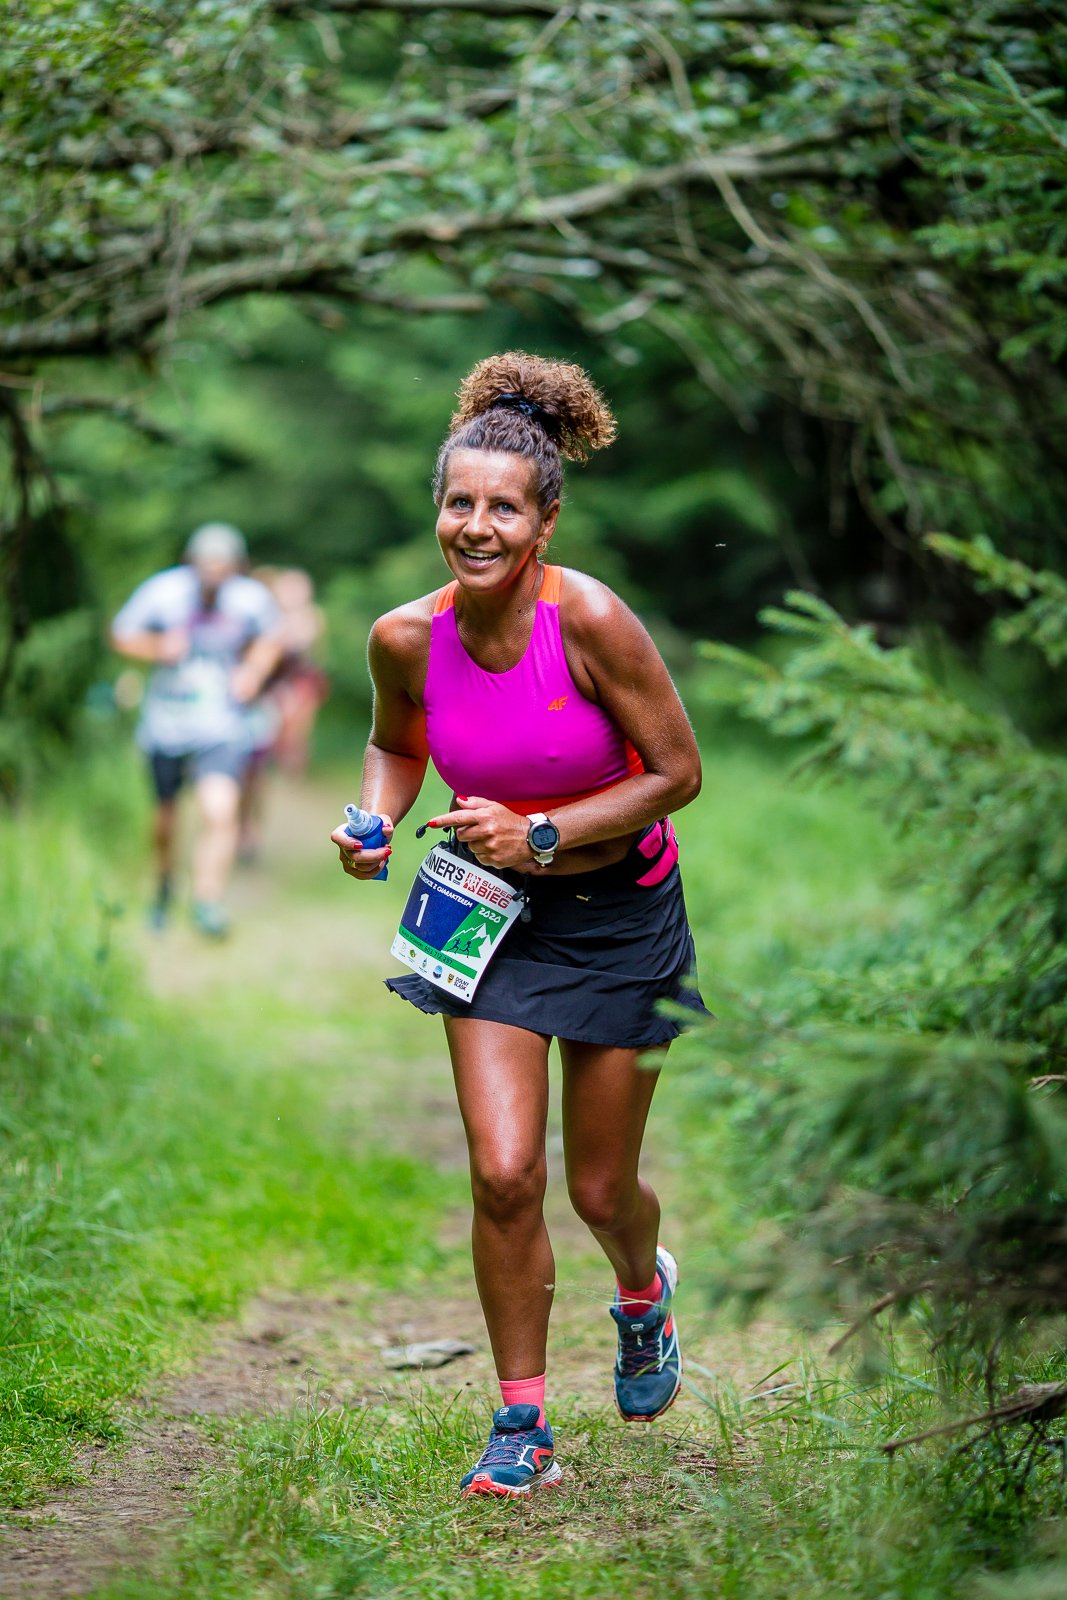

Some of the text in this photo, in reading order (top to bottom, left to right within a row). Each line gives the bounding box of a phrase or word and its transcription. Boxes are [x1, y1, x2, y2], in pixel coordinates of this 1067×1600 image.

[436, 886, 474, 908] CHARAKTEREM
[476, 886, 510, 909] BIEG
[481, 880, 513, 902] SUPER
[415, 893, 430, 928] 1
[478, 907, 502, 923] 2020
